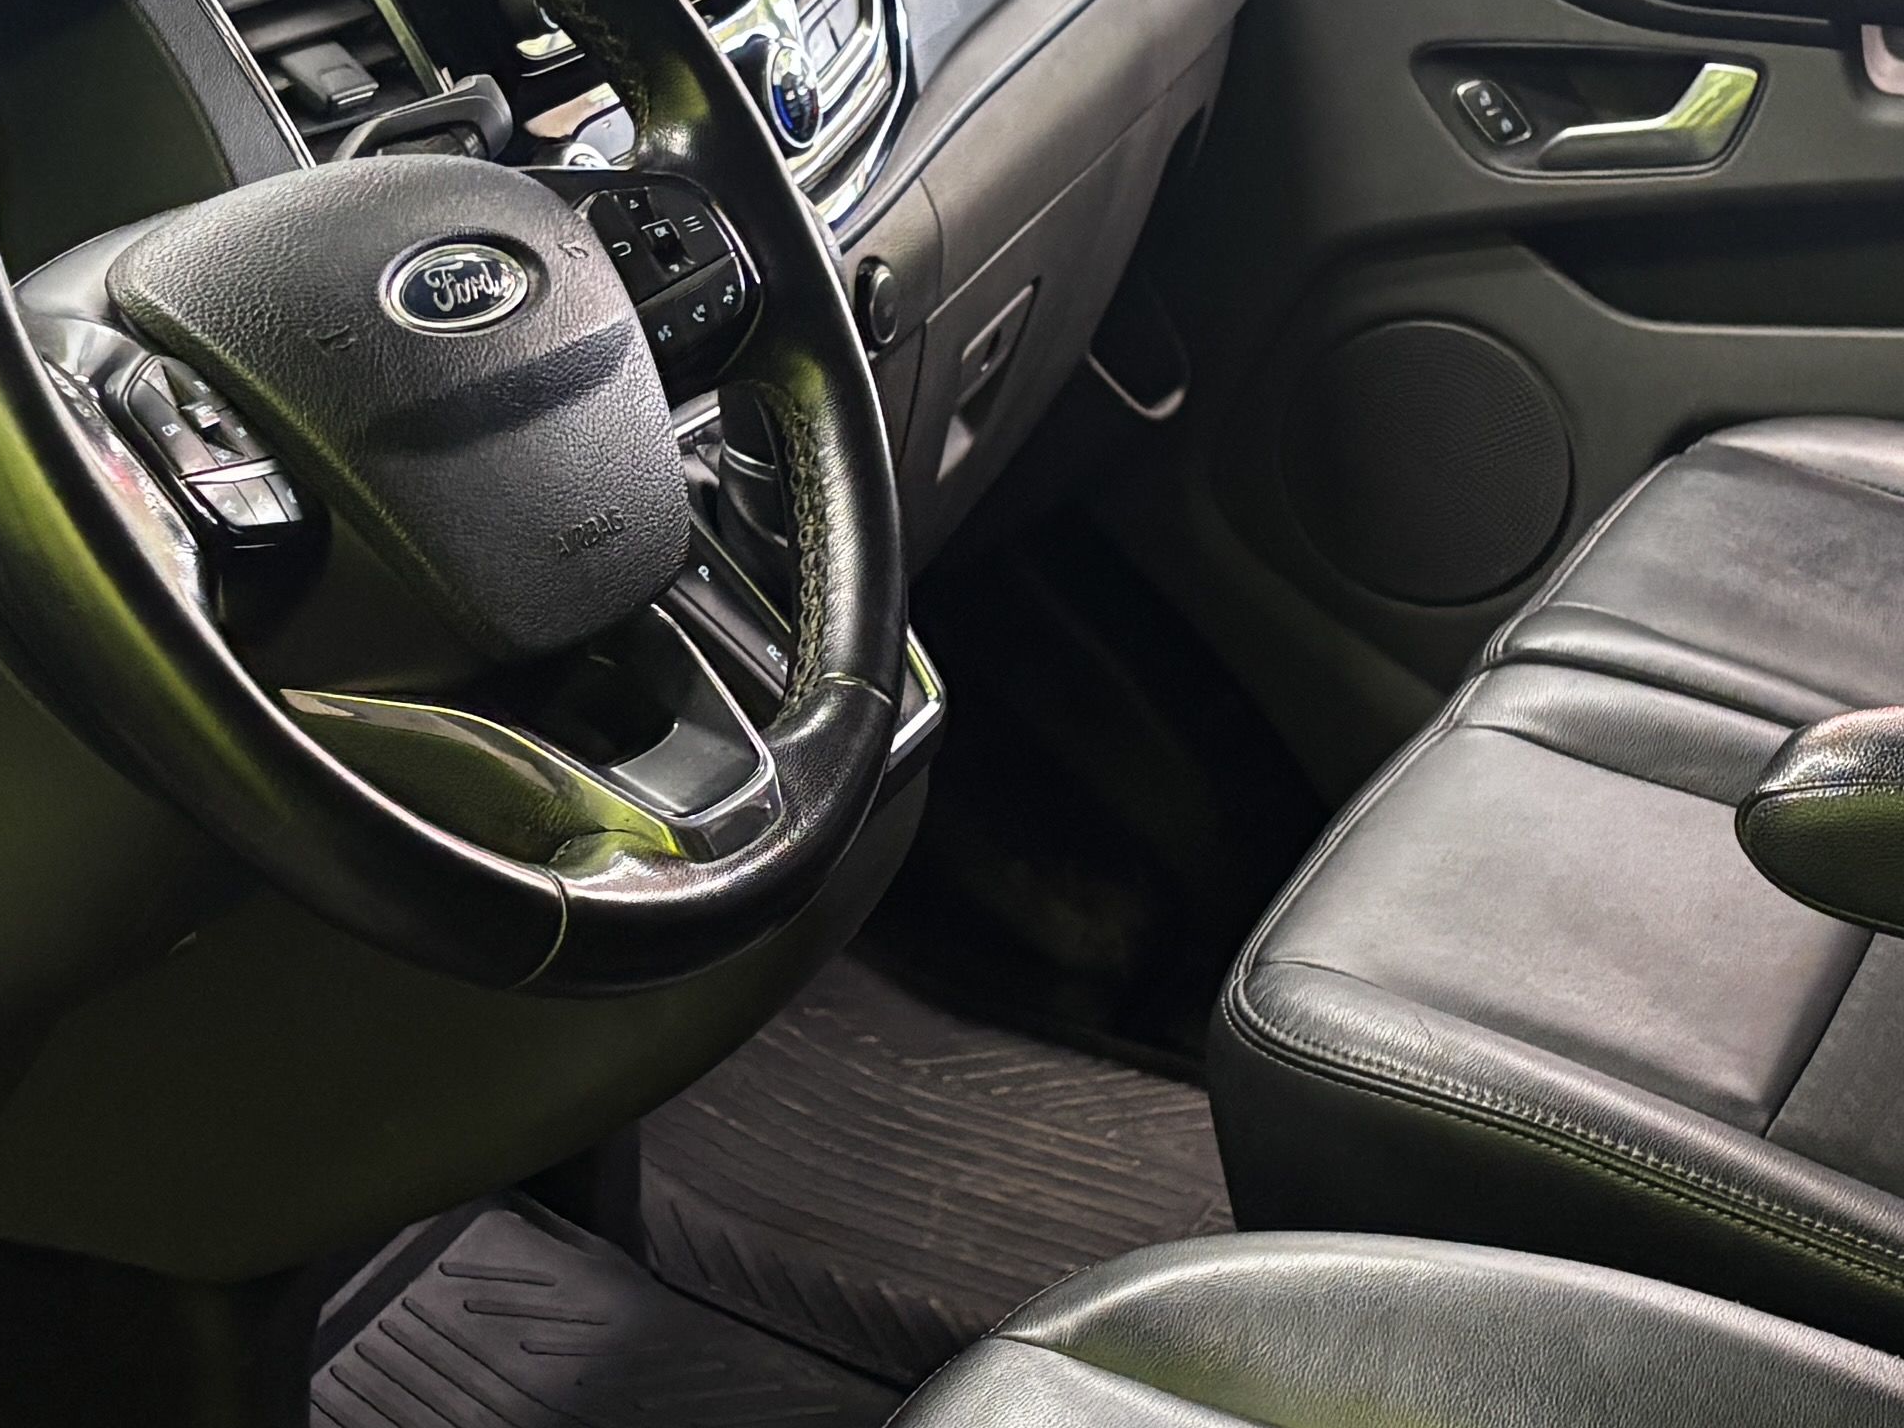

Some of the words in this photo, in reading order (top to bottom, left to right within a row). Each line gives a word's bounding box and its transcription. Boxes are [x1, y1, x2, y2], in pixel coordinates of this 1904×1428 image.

[424, 261, 500, 312] Ford
[697, 565, 711, 582] P
[766, 644, 783, 662] R
